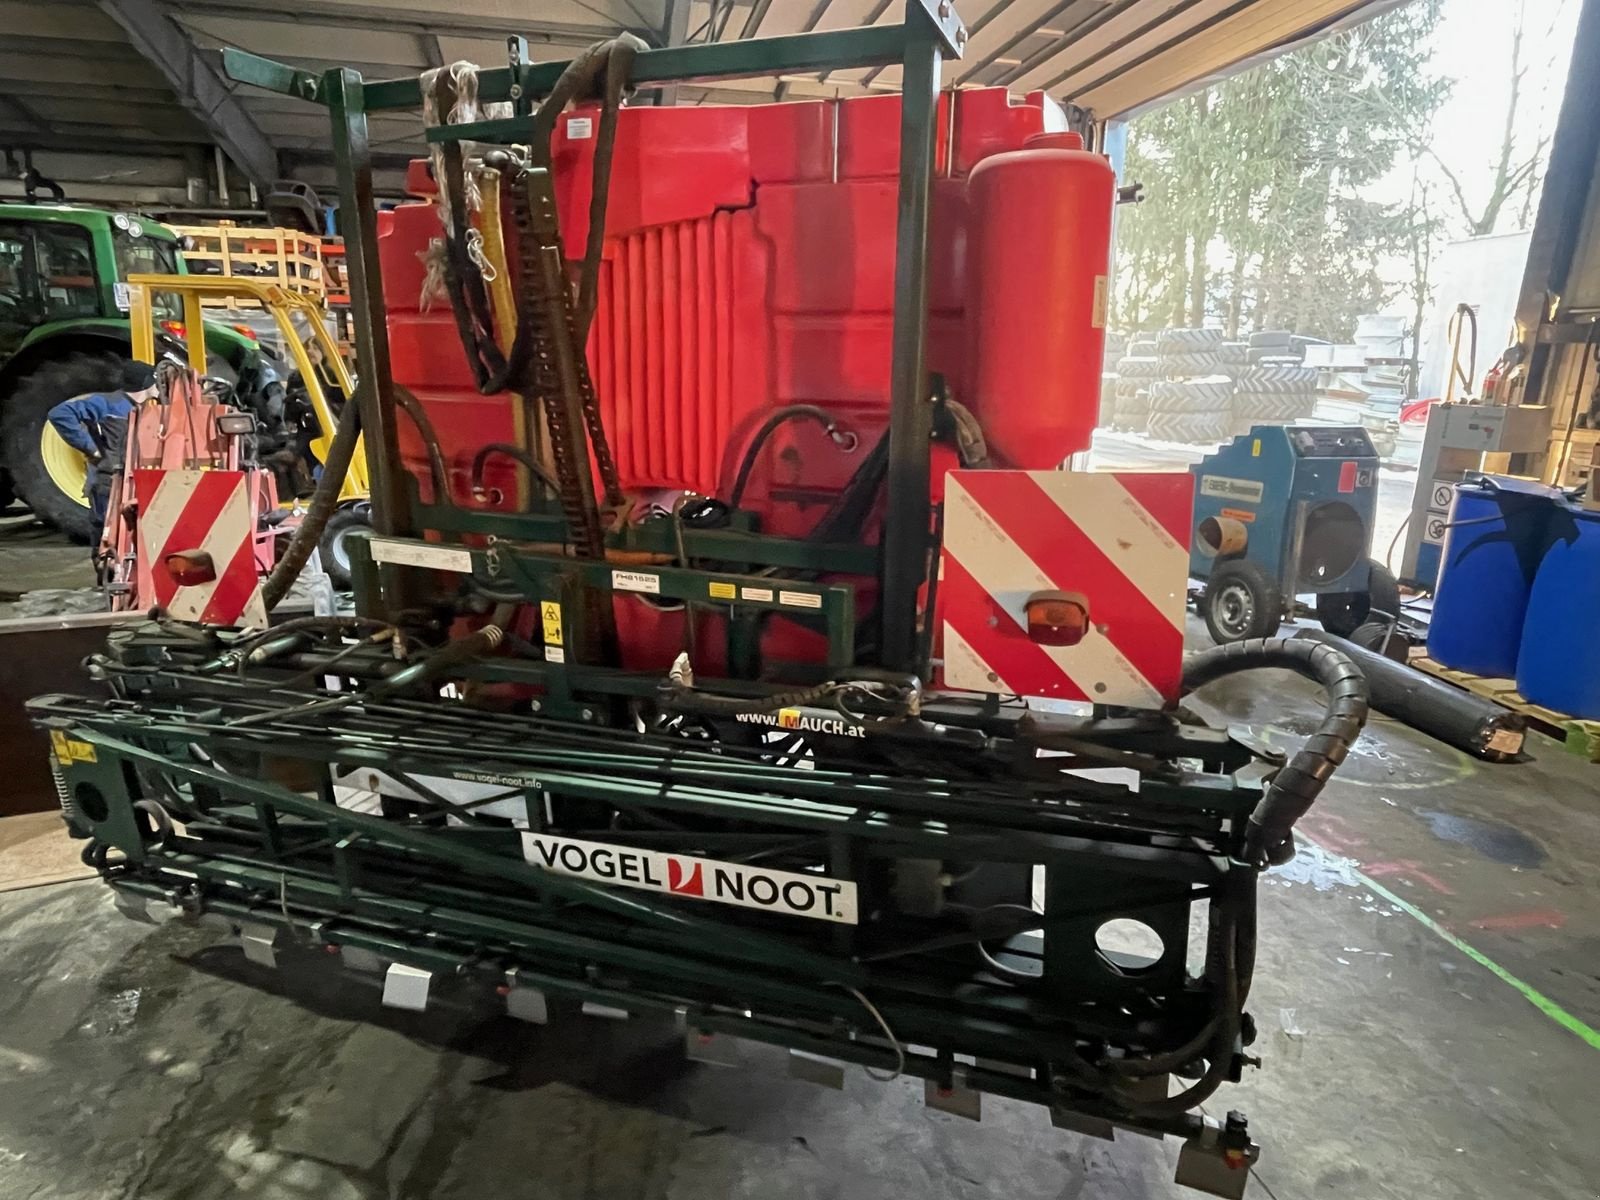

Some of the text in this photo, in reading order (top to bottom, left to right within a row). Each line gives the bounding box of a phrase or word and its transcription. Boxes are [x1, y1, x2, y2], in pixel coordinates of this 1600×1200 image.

[736, 713, 866, 738] www.MAUCH.at
[535, 839, 841, 916] VOGEL NOOT
